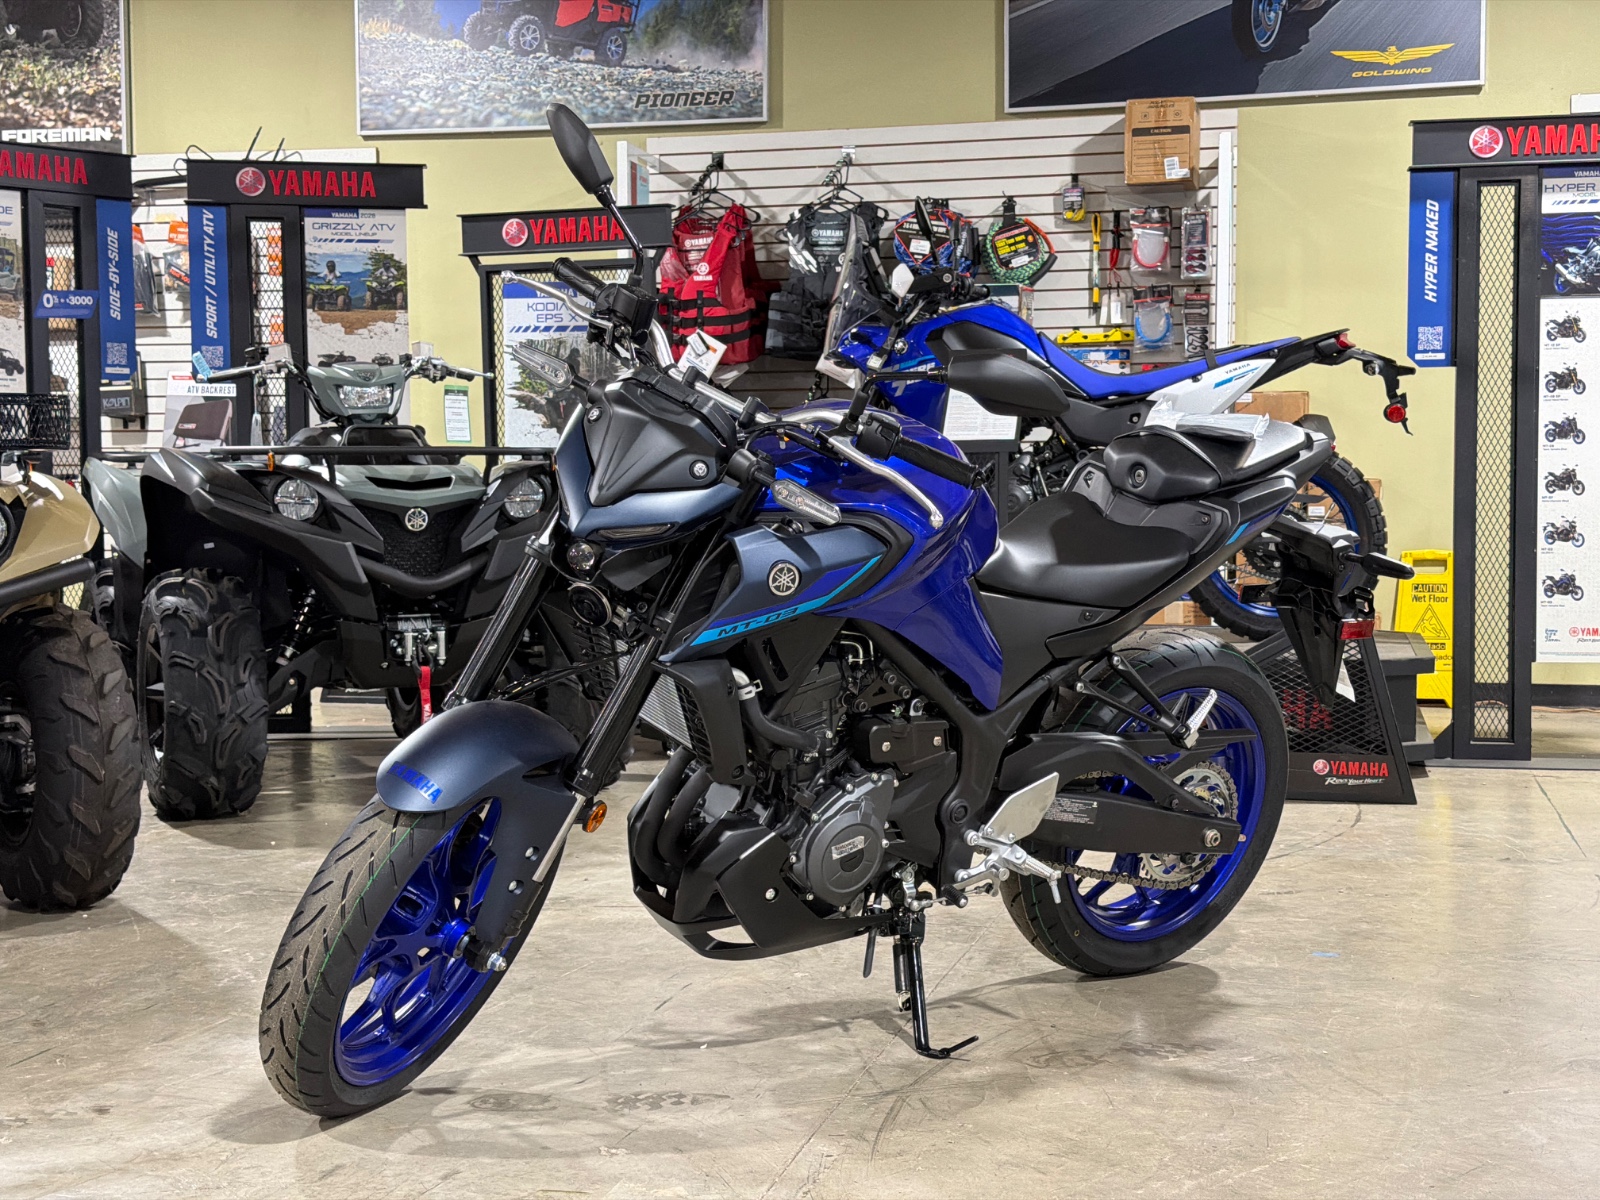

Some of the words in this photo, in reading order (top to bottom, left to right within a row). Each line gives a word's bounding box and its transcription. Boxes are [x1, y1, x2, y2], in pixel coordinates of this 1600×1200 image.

[1352, 67, 1432, 77] GOLDWING
[634, 90, 735, 109] PIONEER
[1, 127, 113, 143] FOREMAN
[268, 169, 377, 197] YAMAHA
[1544, 183, 1596, 192] HYPER
[202, 208, 215, 237] ATV
[312, 222, 365, 231] GRIZZLY
[370, 223, 396, 231] ATV
[529, 215, 625, 245] YAMAHA
[1425, 198, 1440, 252] NAKED
[819, 229, 844, 237] YAMAHA
[203, 235, 216, 286] UTILITY
[107, 227, 121, 321] SIDE-BY-SIDE
[1424, 252, 1438, 303] HYPER
[205, 295, 218, 339] SPORT
[536, 313, 564, 323] EPS
[1225, 363, 1251, 375] YAMAHA
[187, 385, 199, 394] ATV
[200, 385, 236, 395] BACKREST
[1412, 584, 1447, 592] CAUTION
[1411, 594, 1426, 602] Wet
[1429, 594, 1449, 602] Floor
[717, 607, 799, 637] MT-03
[1330, 760, 1389, 777] YAMAHA
[386, 760, 443, 804] YAMAHA
[1325, 776, 1347, 785] Revs
